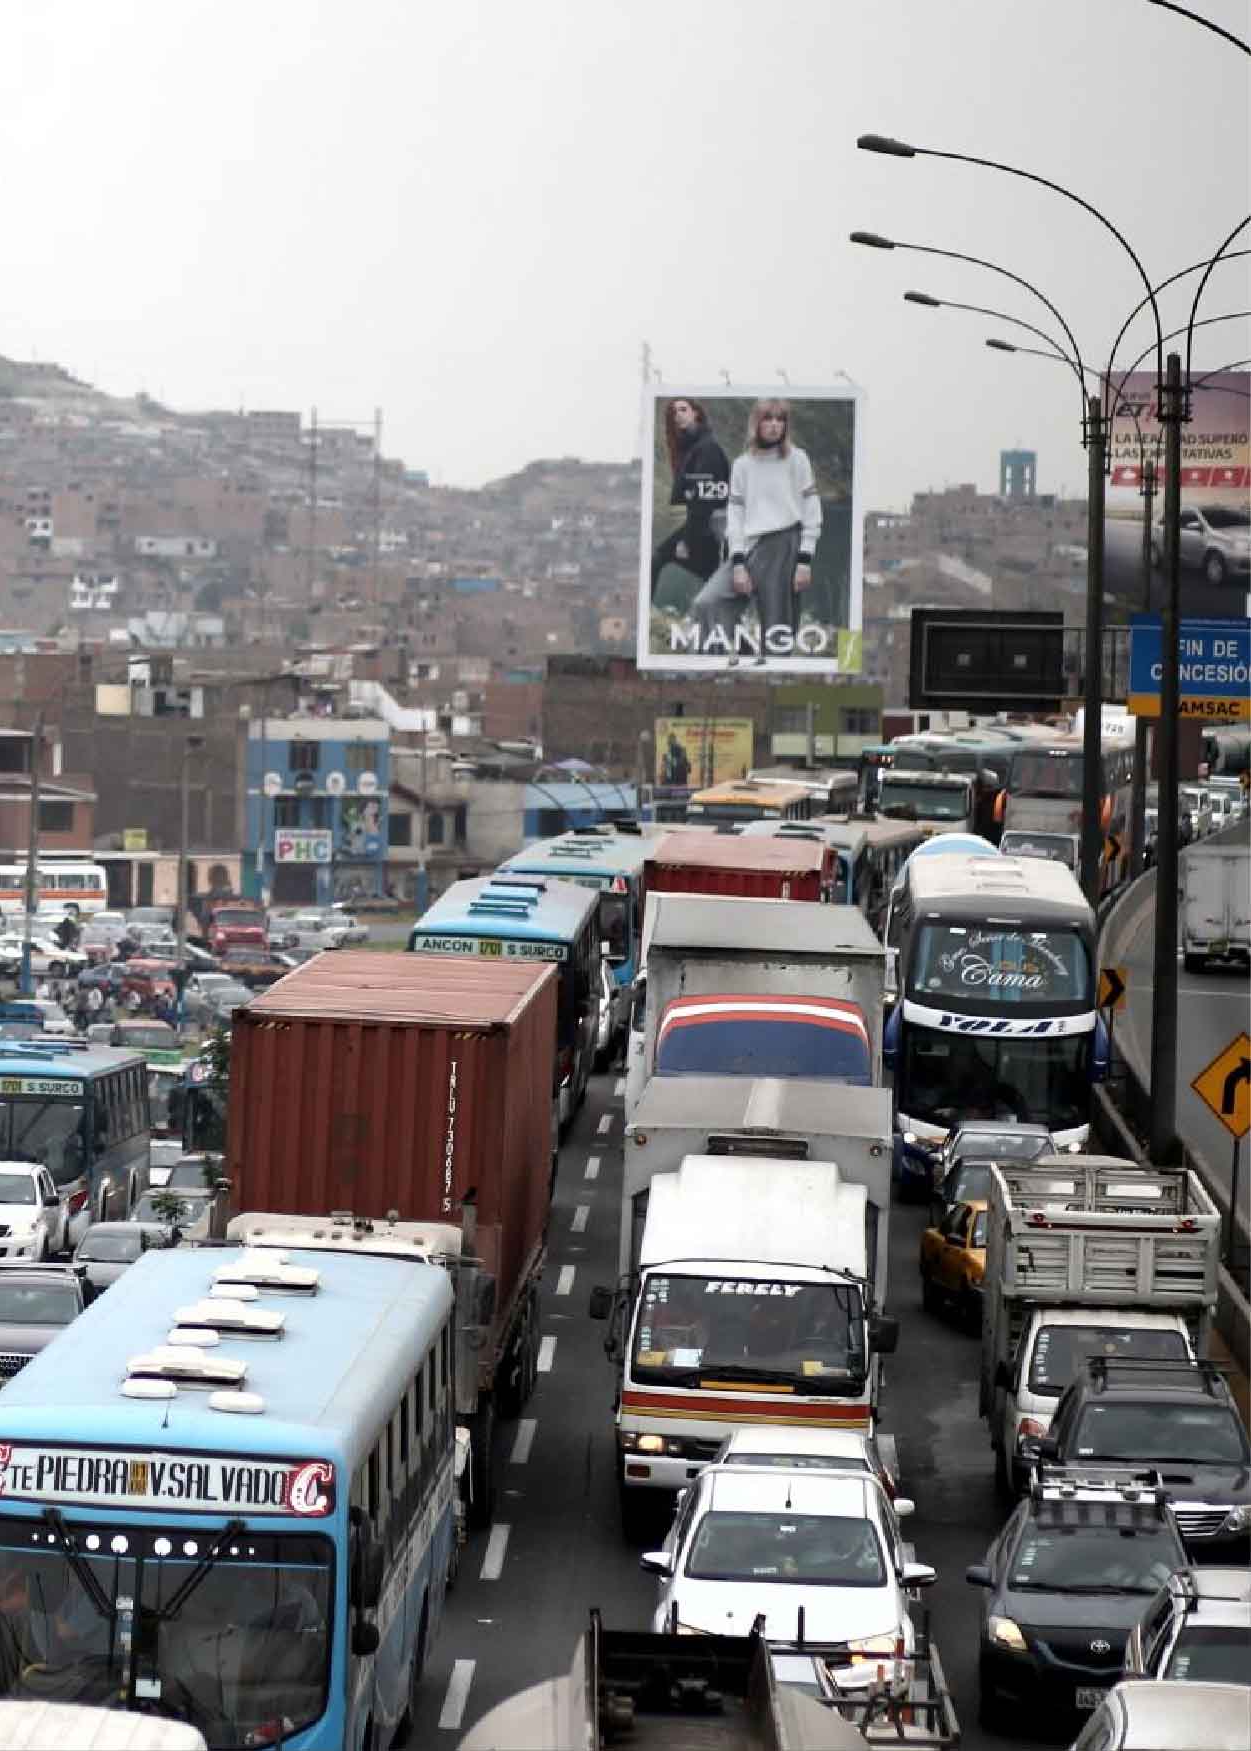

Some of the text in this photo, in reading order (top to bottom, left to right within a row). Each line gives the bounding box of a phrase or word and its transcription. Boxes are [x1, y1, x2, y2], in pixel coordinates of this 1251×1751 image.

[671, 623, 828, 655] MANGO
[1214, 640, 1239, 657] DE
[1150, 661, 1251, 681] CNCESIÓ
[1177, 701, 1241, 715] AMSAC
[37, 1454, 128, 1495] PIEDRA
